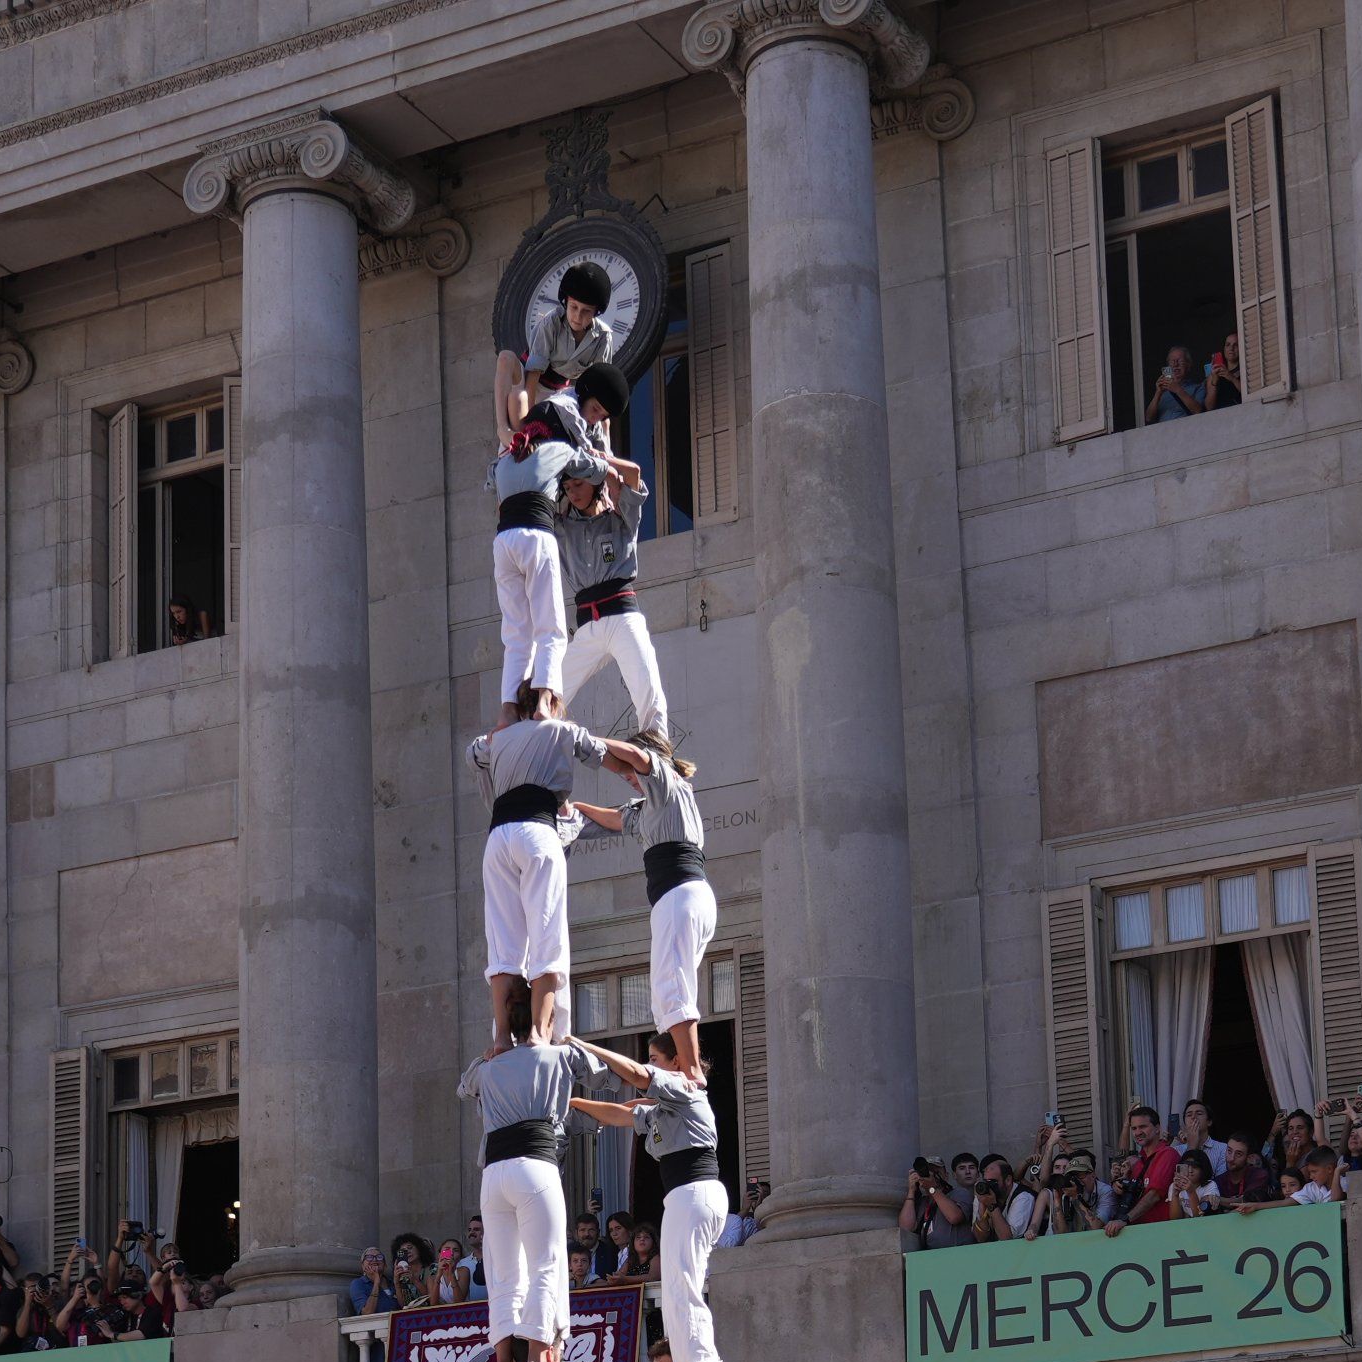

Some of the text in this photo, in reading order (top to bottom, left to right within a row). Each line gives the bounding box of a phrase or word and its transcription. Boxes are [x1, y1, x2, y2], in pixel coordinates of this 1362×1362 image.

[702, 809, 760, 832] CELON
[919, 1241, 1332, 1356] MERCÈ 26
